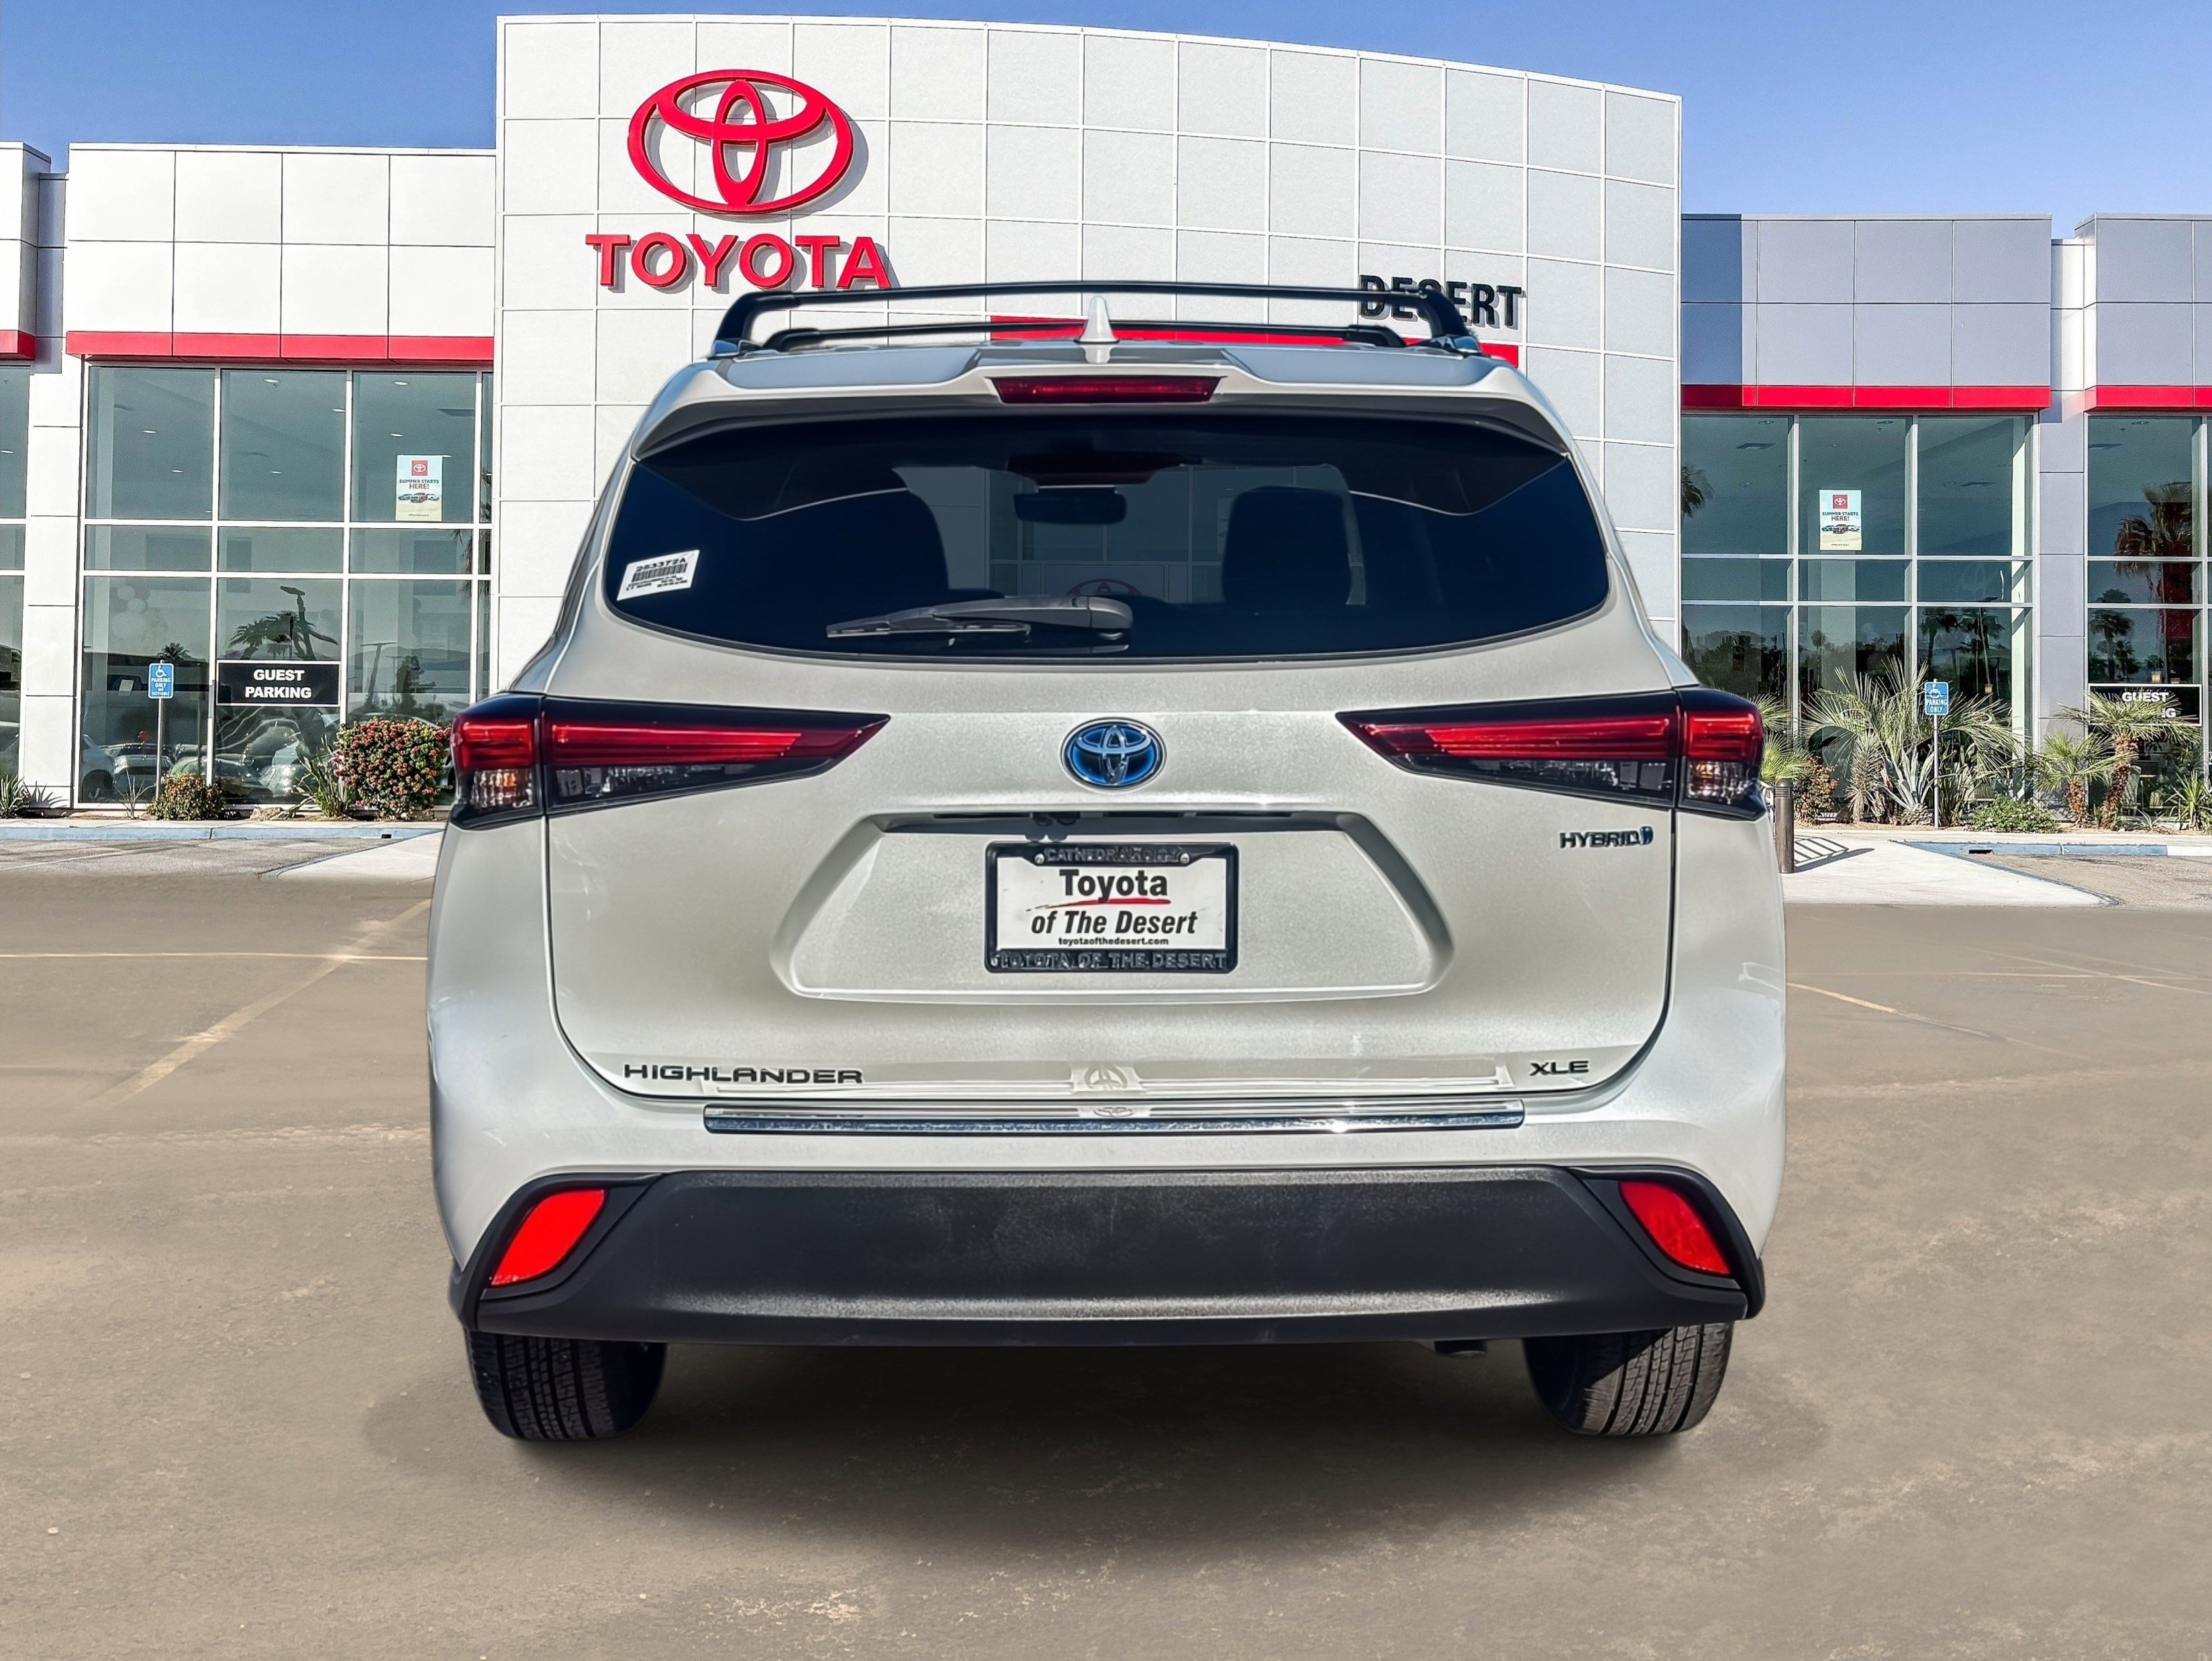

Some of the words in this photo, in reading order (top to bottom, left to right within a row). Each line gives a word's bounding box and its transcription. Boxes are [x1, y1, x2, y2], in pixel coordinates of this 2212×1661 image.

[585, 232, 893, 289] TOYOTA
[253, 669, 305, 681] GUEST
[245, 686, 311, 699] PARKING
[2121, 692, 2169, 702] GUEST
[1560, 830, 1640, 848] HYBRID
[1060, 869, 1167, 902] Toyota
[1032, 911, 1058, 934] of
[1065, 911, 1107, 934] The
[1115, 911, 1198, 934] Desert
[1058, 937, 1168, 945] toyotaofthedesert.com
[1109, 952, 1146, 968] THE
[1152, 953, 1227, 968] DESERT
[624, 1064, 862, 1083] HIGHLANDER
[1529, 1060, 1589, 1076] XLE
